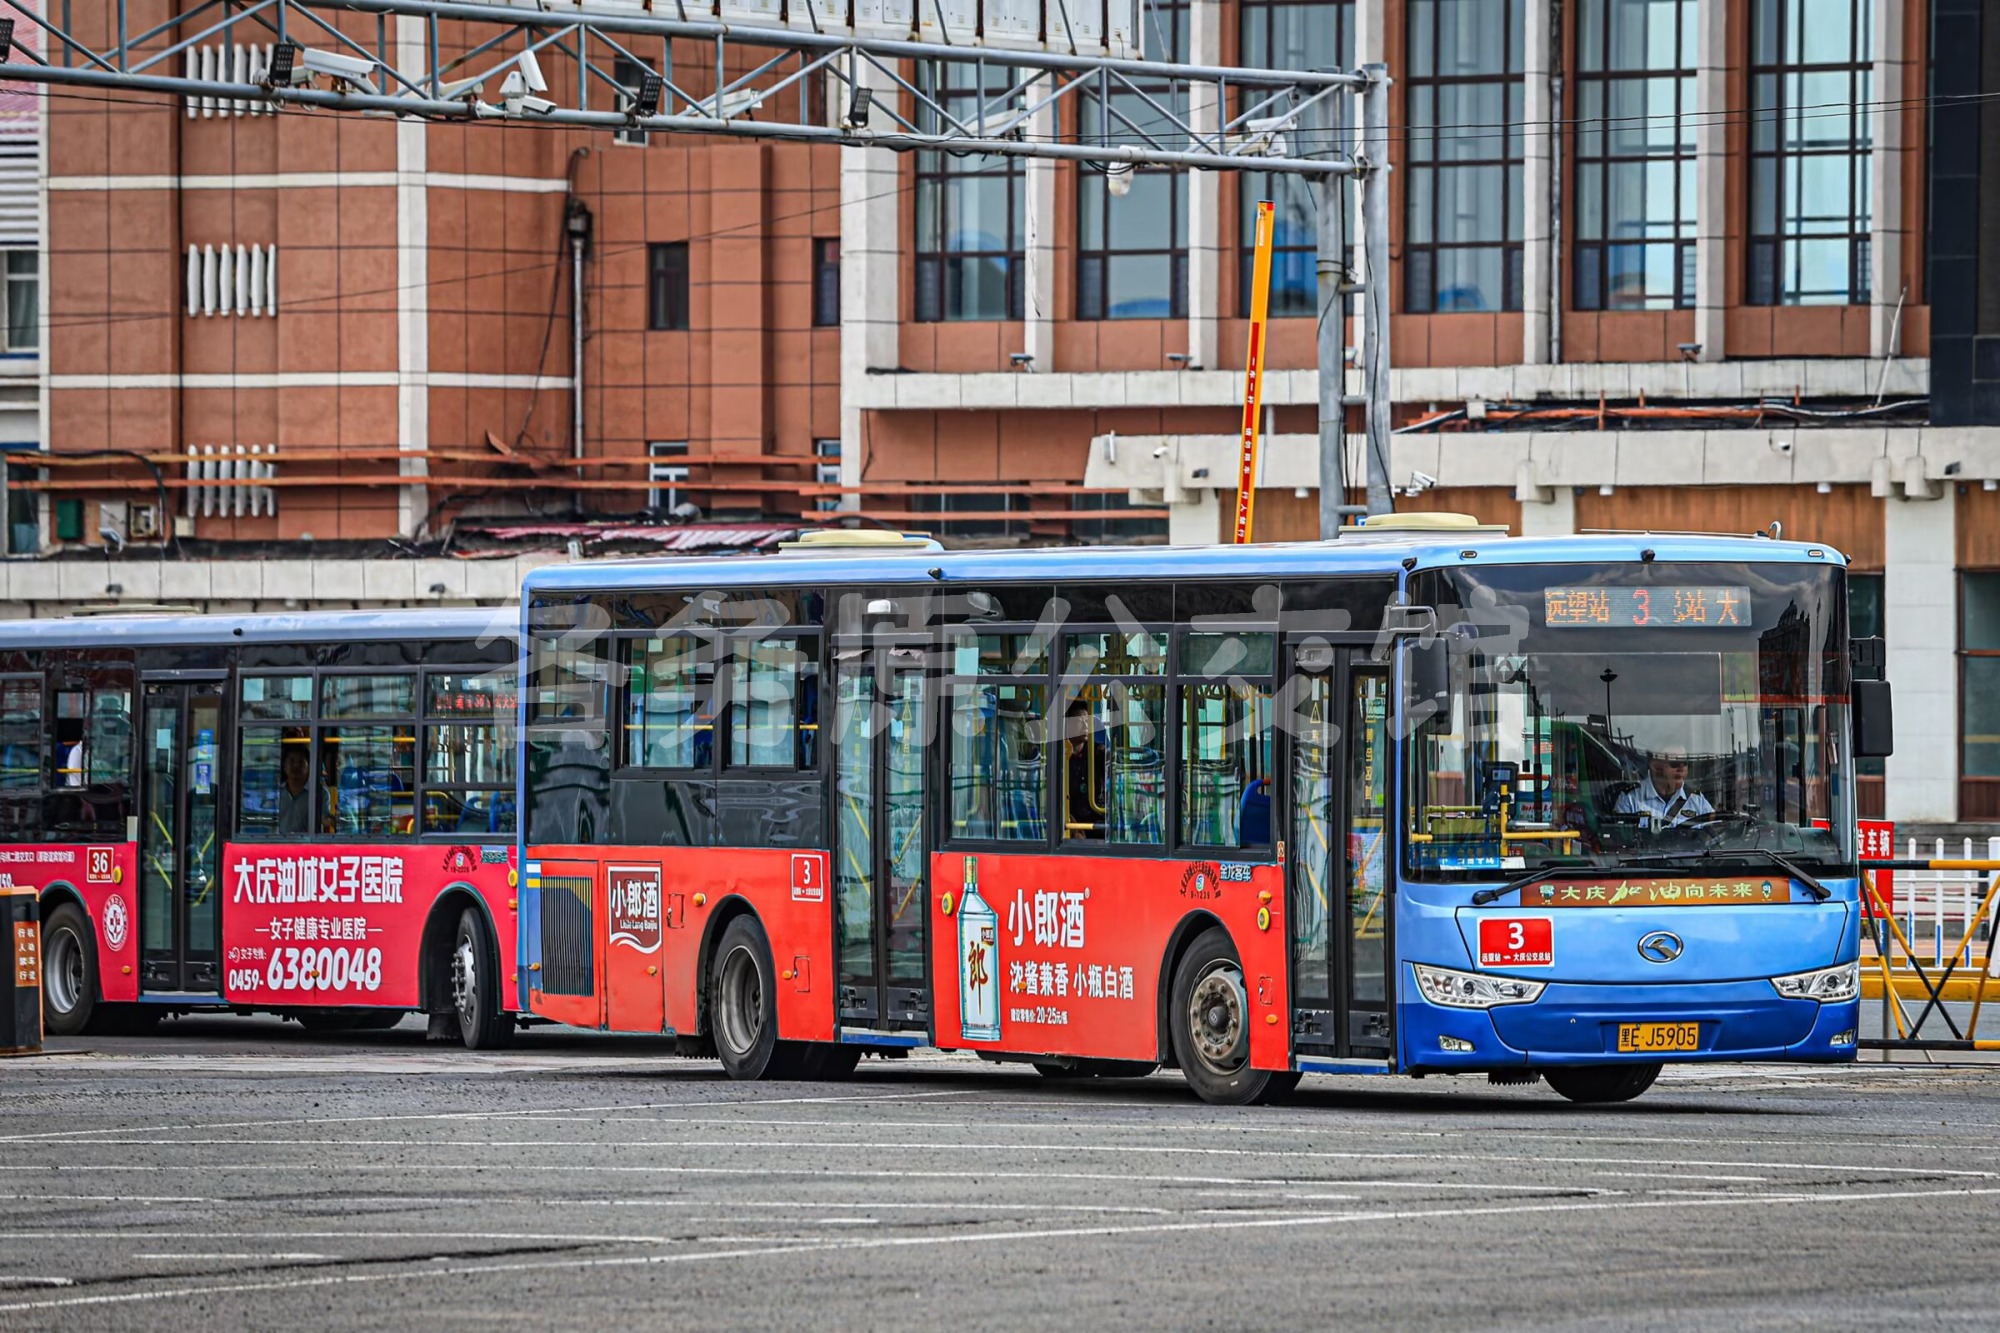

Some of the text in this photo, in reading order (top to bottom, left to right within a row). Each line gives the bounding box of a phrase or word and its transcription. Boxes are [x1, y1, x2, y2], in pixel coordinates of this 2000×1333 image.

[1237, 491, 1249, 538] 行人禁行
[1545, 589, 1610, 623] 远望站
[1632, 589, 1650, 625] 3
[1715, 589, 1739, 624] 大
[92, 852, 108, 873] 36
[233, 856, 404, 904] 大庆油城女子医院
[803, 860, 811, 885] 3
[612, 880, 658, 918] 小郎酒
[1560, 880, 1753, 905] 大庆加油向未来
[270, 916, 367, 940] 女子健康专业医院
[1008, 889, 1085, 948] 小郎酒
[1508, 922, 1525, 950] 3
[228, 946, 382, 991] 0459- 6380048
[1010, 960, 1134, 1000] 浓酱兼香 小瓶白酒
